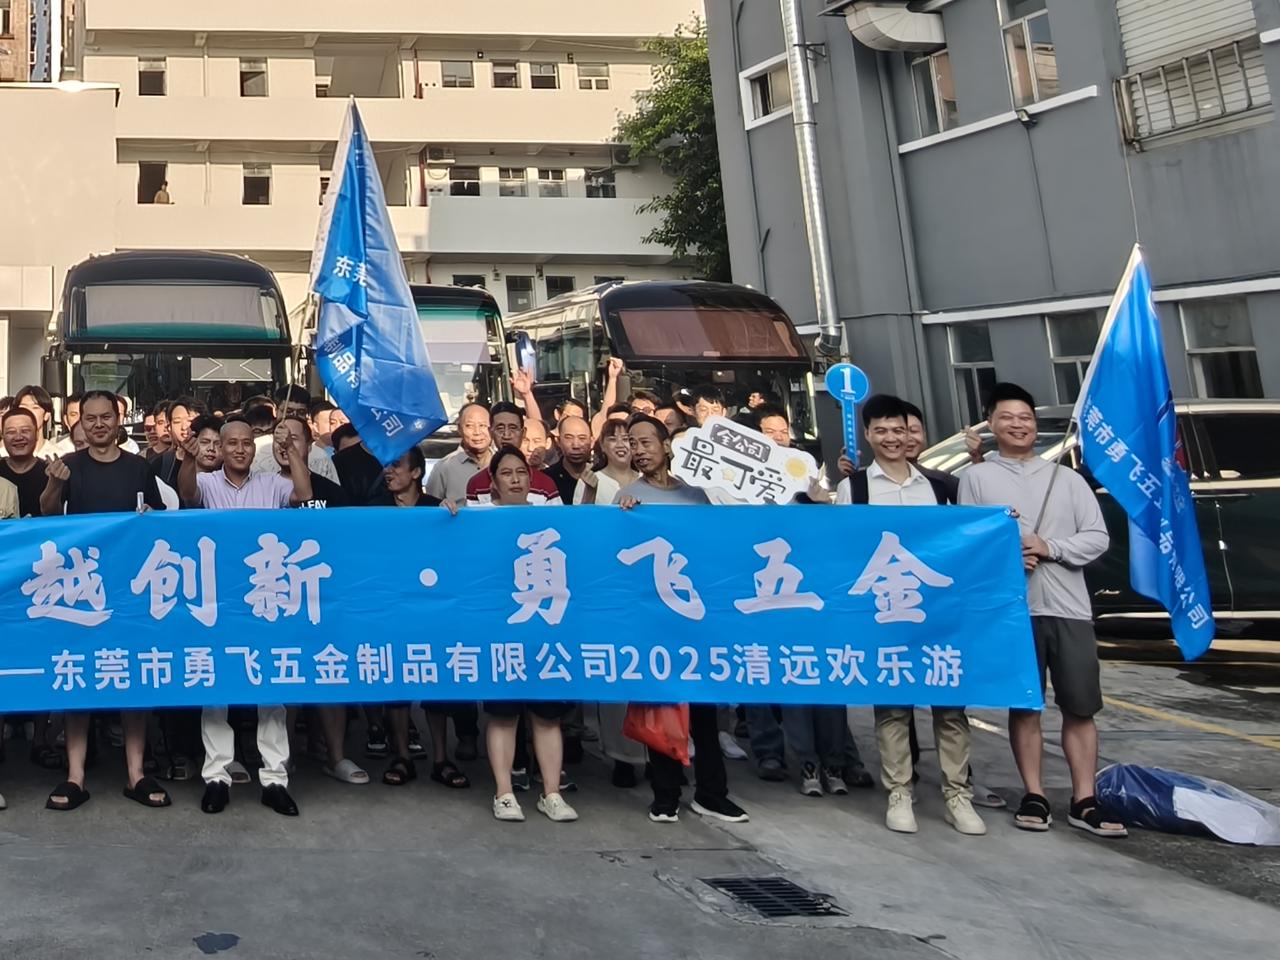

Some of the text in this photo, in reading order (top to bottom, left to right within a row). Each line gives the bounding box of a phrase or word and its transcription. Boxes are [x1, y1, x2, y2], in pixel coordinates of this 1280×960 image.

[840, 368, 856, 394] 1
[680, 436, 787, 501] 最可爱
[506, 526, 954, 626] 勇飞五金
